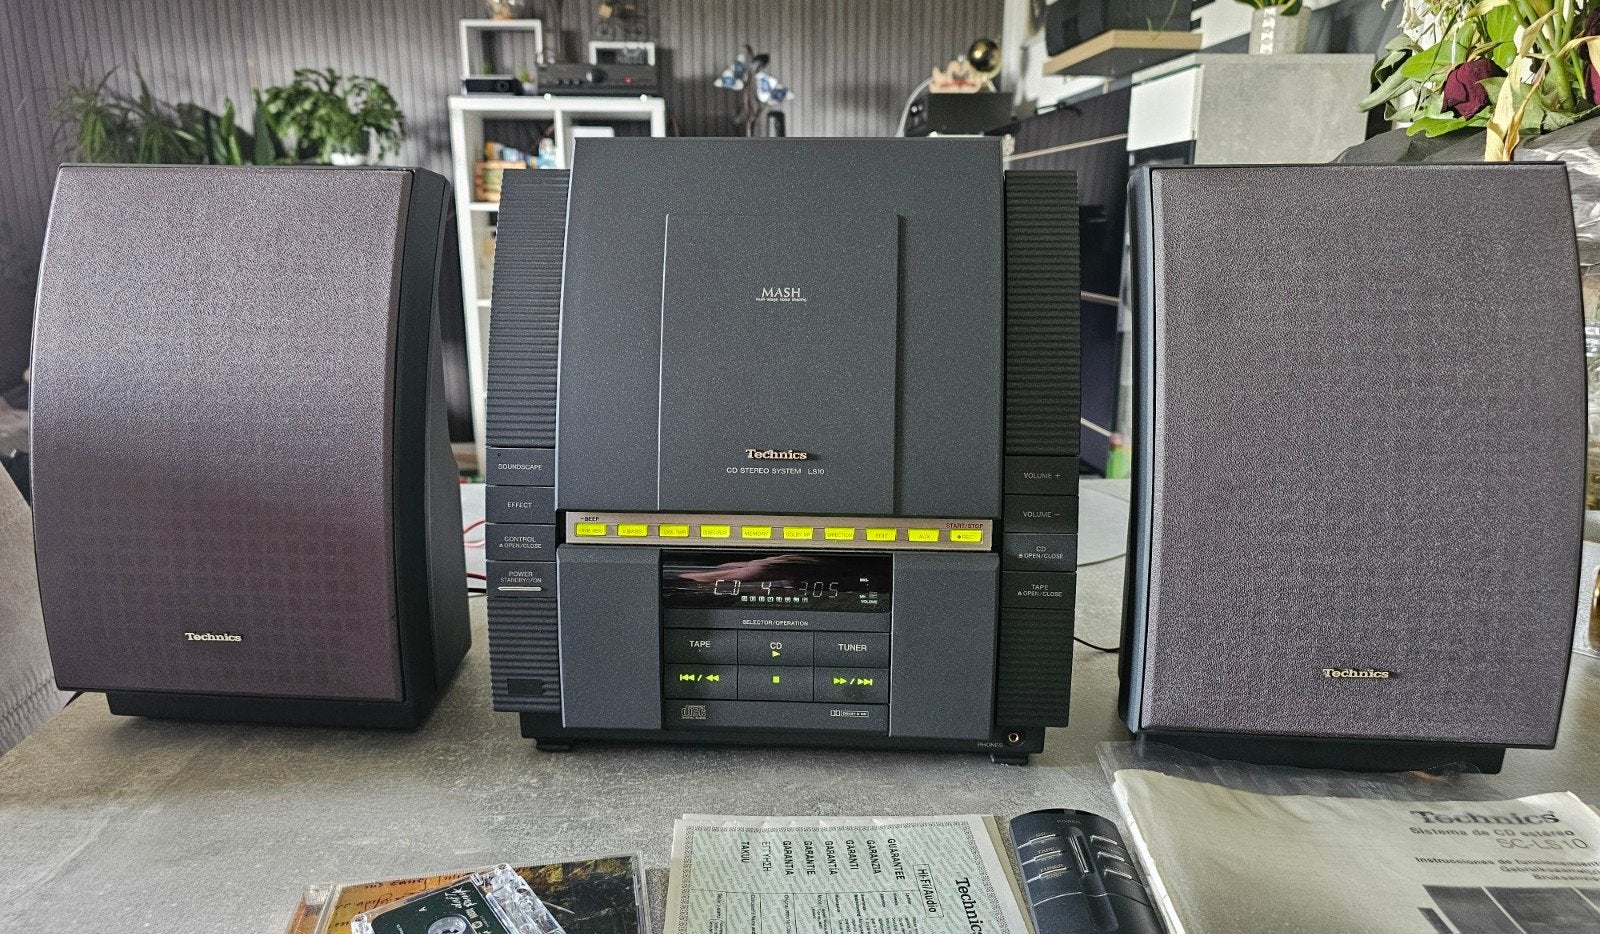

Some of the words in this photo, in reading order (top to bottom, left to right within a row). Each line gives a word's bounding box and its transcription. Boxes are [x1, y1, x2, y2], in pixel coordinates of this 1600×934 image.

[761, 287, 801, 298] MASH
[745, 448, 807, 460] Technics
[497, 463, 543, 471] SOUNDSCAPE
[771, 467, 802, 475] SYSTEM
[507, 501, 533, 509] EFFECT
[1022, 510, 1052, 518] VOLUME
[742, 619, 809, 627] SELECTOR/OPERATION
[184, 632, 243, 642] Technics
[689, 640, 711, 648] TAPE
[769, 642, 783, 650] CD
[838, 643, 868, 652] TUNER
[1322, 667, 1390, 679] Technics
[1409, 810, 1560, 825] Technics
[1409, 826, 1468, 836] Sistema
[1472, 828, 1490, 836] de
[1493, 829, 1515, 837] CD
[741, 841, 750, 864] TAKUU
[782, 840, 795, 876] GARANTIA
[803, 840, 816, 876] GARANTIE
[845, 839, 859, 870] GARANTI
[866, 839, 882, 875] GARANZIA
[887, 838, 906, 881] GUARANTEE
[1414, 856, 1495, 865] Instrucciones
[1514, 858, 1600, 867] funcionamient
[917, 868, 938, 913] Hi-Fi/Audio
